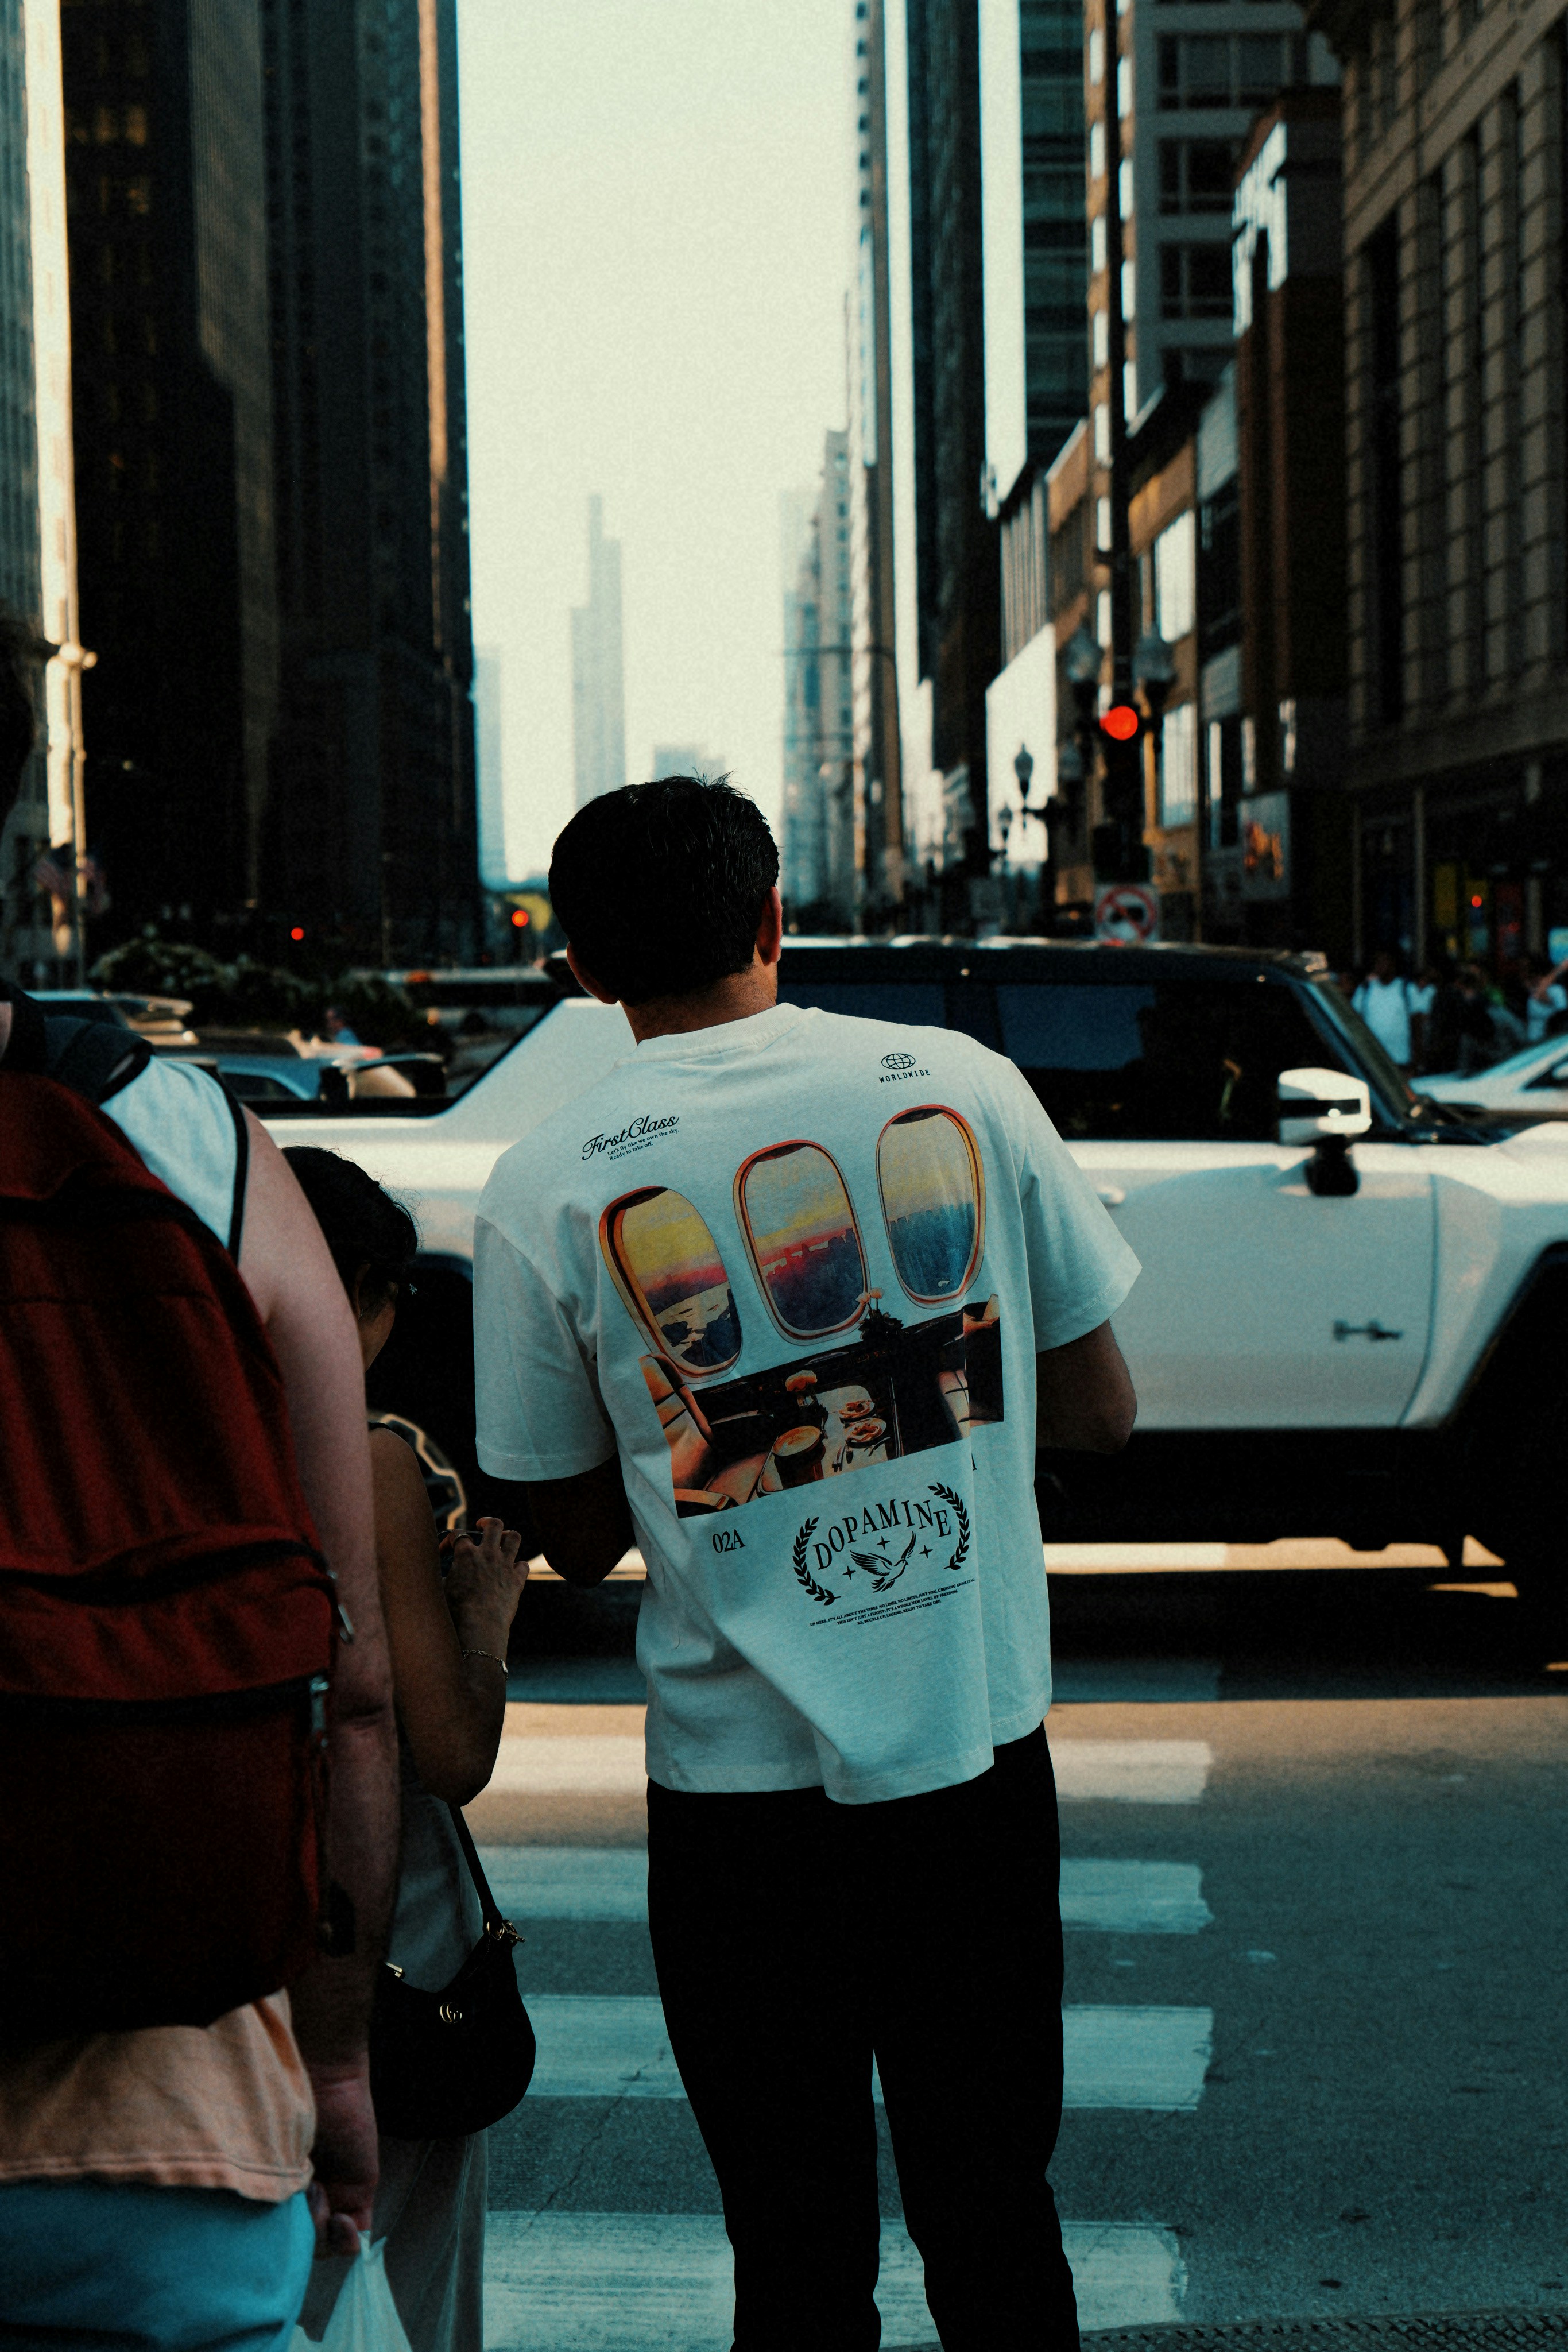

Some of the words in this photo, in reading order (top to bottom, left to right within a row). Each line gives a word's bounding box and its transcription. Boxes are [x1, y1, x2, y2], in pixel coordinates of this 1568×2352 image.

[879, 1070, 930, 1083] WORLDWIDE
[609, 1152, 625, 1160] Ready
[712, 1529, 746, 1553] 02A
[812, 1499, 952, 1570] DOPAMINE
[938, 1584, 956, 1592] CRUISING
